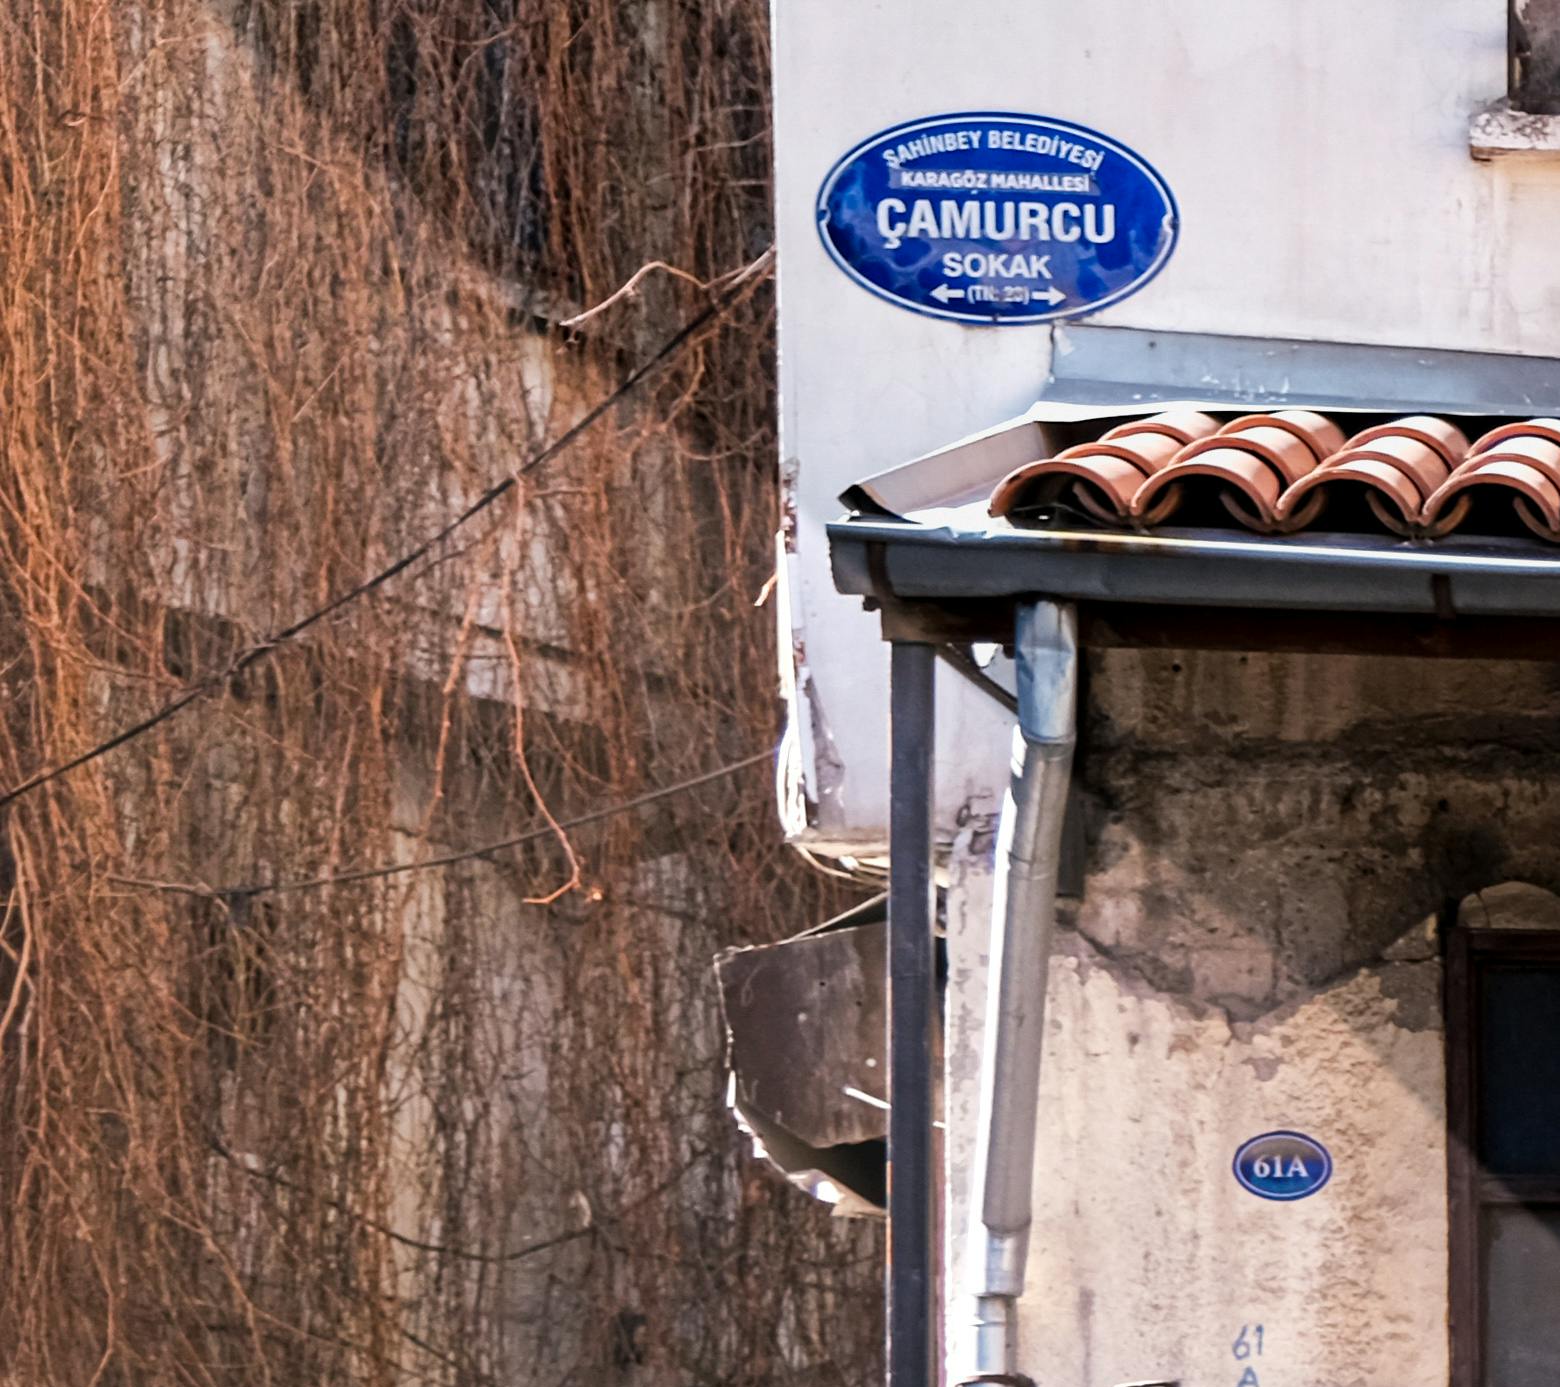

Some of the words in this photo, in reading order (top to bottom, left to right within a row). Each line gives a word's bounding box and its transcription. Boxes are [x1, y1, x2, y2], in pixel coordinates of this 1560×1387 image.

[882, 130, 982, 170] ŞAHİNBEY
[988, 130, 1105, 171] BELEDİYESİ
[901, 170, 988, 189] KARAGÖZ
[991, 173, 1090, 192] MAHALLESİ
[876, 198, 1115, 250] ÇAMURCU
[942, 252, 1053, 279] SOKAK
[1253, 1154, 1309, 1178] 61A
[1232, 1324, 1264, 1361] 61
